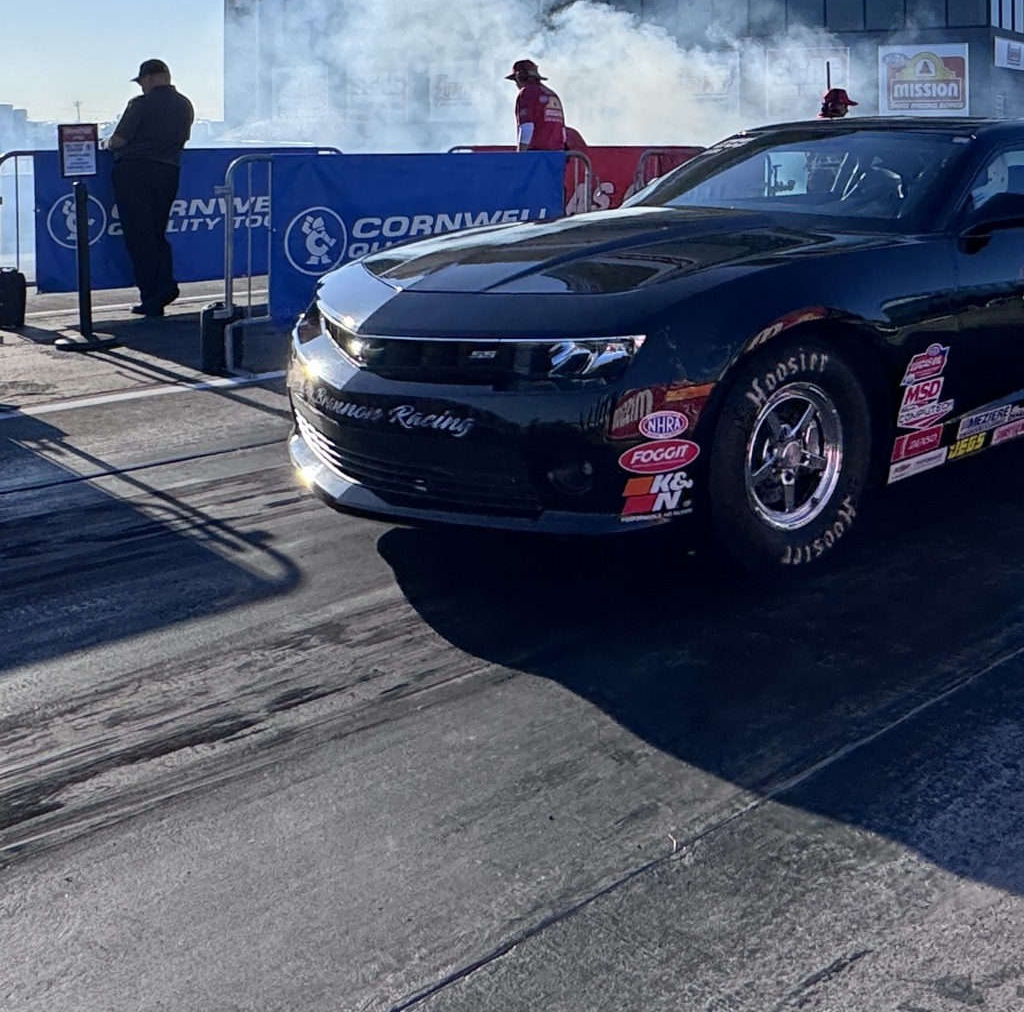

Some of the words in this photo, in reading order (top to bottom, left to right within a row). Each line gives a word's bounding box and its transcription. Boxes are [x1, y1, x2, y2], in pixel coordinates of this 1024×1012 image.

[107, 217, 221, 236] QLITY
[746, 348, 828, 408] Hoosier
[904, 379, 941, 406] MSD
[388, 404, 476, 438] Racing
[647, 416, 683, 433] NHRA
[630, 444, 690, 466] FOGGIT
[949, 432, 985, 459] JEGS
